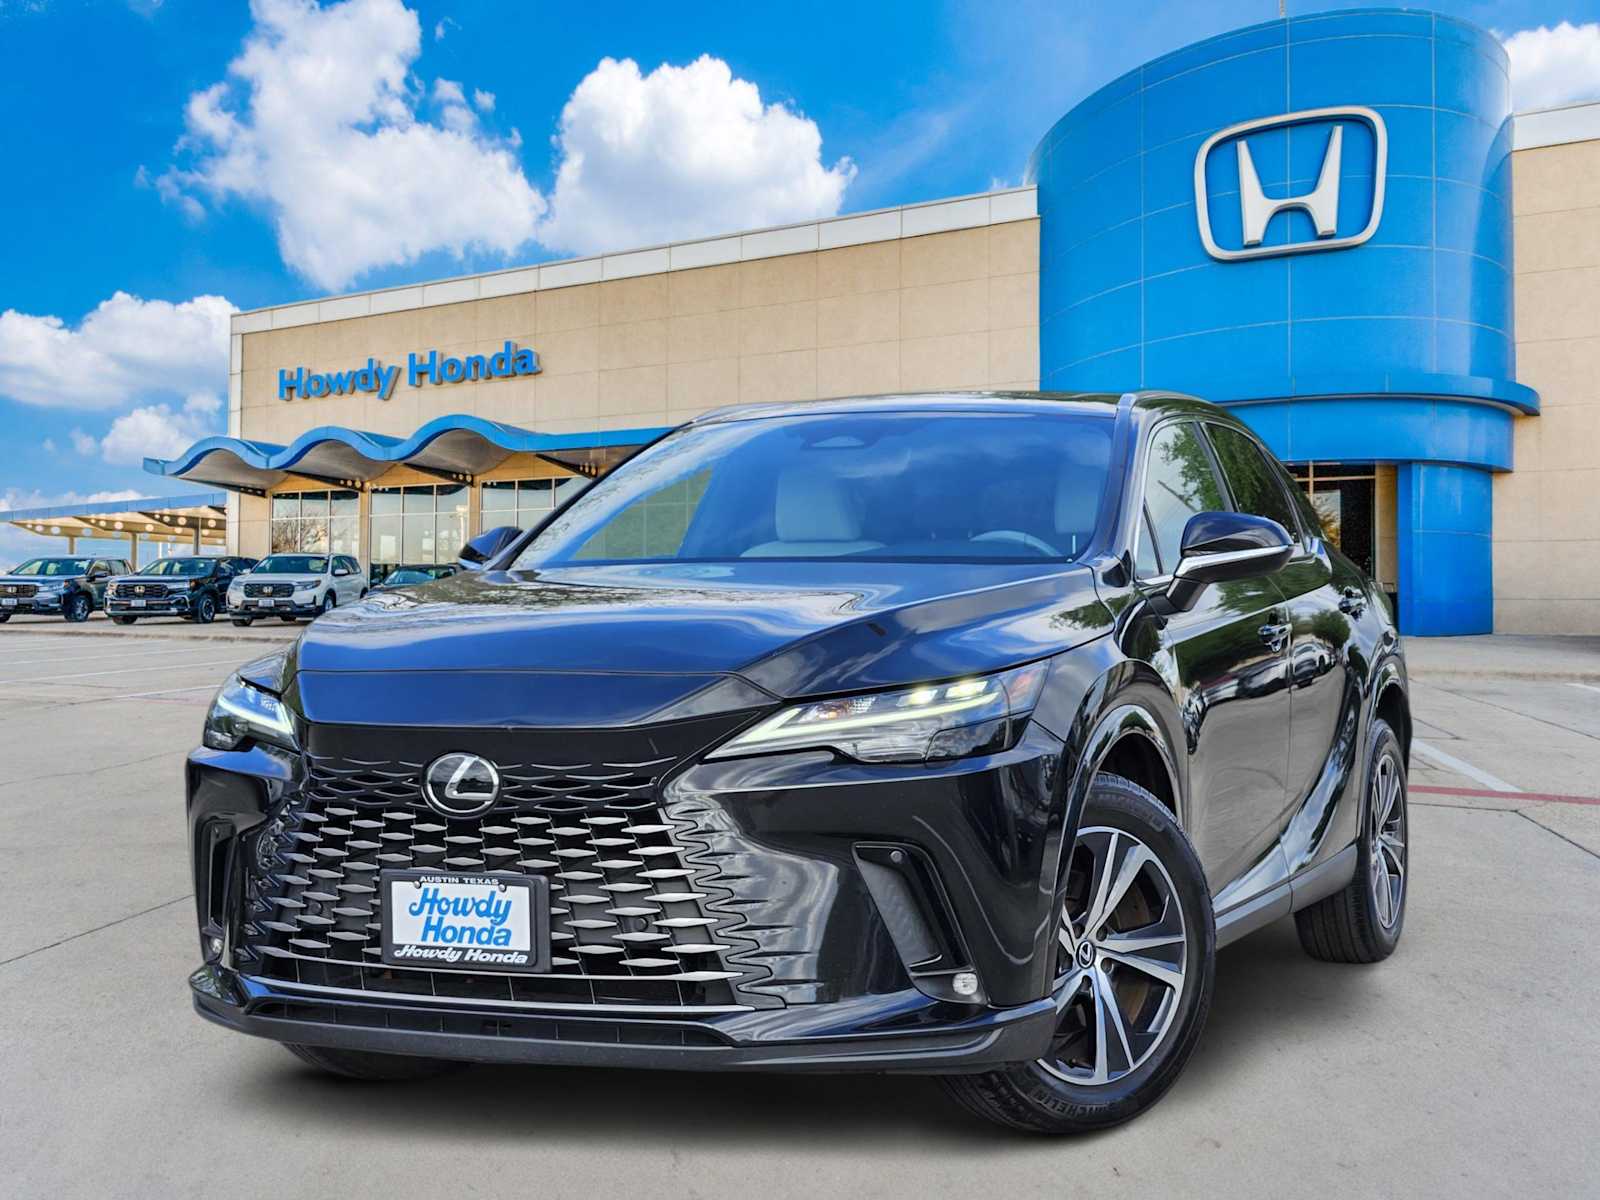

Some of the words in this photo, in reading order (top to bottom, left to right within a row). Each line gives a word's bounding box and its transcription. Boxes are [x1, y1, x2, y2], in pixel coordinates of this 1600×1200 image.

[278, 358, 401, 400] Howdy
[408, 341, 541, 387] Honda
[419, 876, 460, 884] AUSTIN
[463, 877, 499, 885] TEXAS
[409, 887, 512, 925] Howdy
[421, 916, 512, 946] Honda
[394, 945, 463, 963] Howdy
[464, 949, 528, 964] Honda
